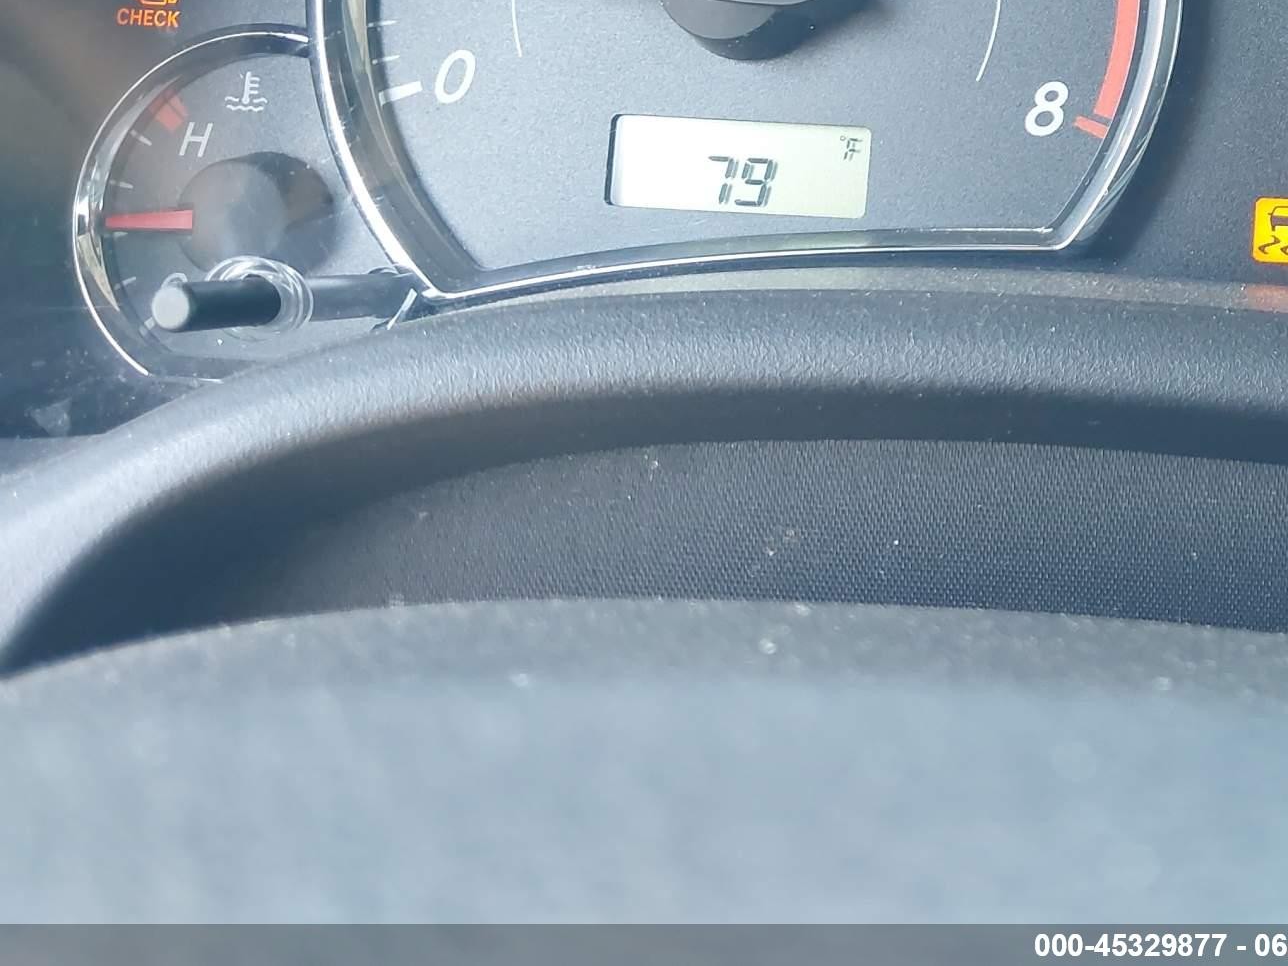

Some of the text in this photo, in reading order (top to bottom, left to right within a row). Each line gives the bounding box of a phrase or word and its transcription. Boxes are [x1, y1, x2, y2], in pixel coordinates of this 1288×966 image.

[117, 8, 180, 28] CHECK
[434, 49, 476, 104] 0
[1025, 81, 1068, 136] 8
[179, 123, 213, 157] H
[708, 156, 777, 207] 79
